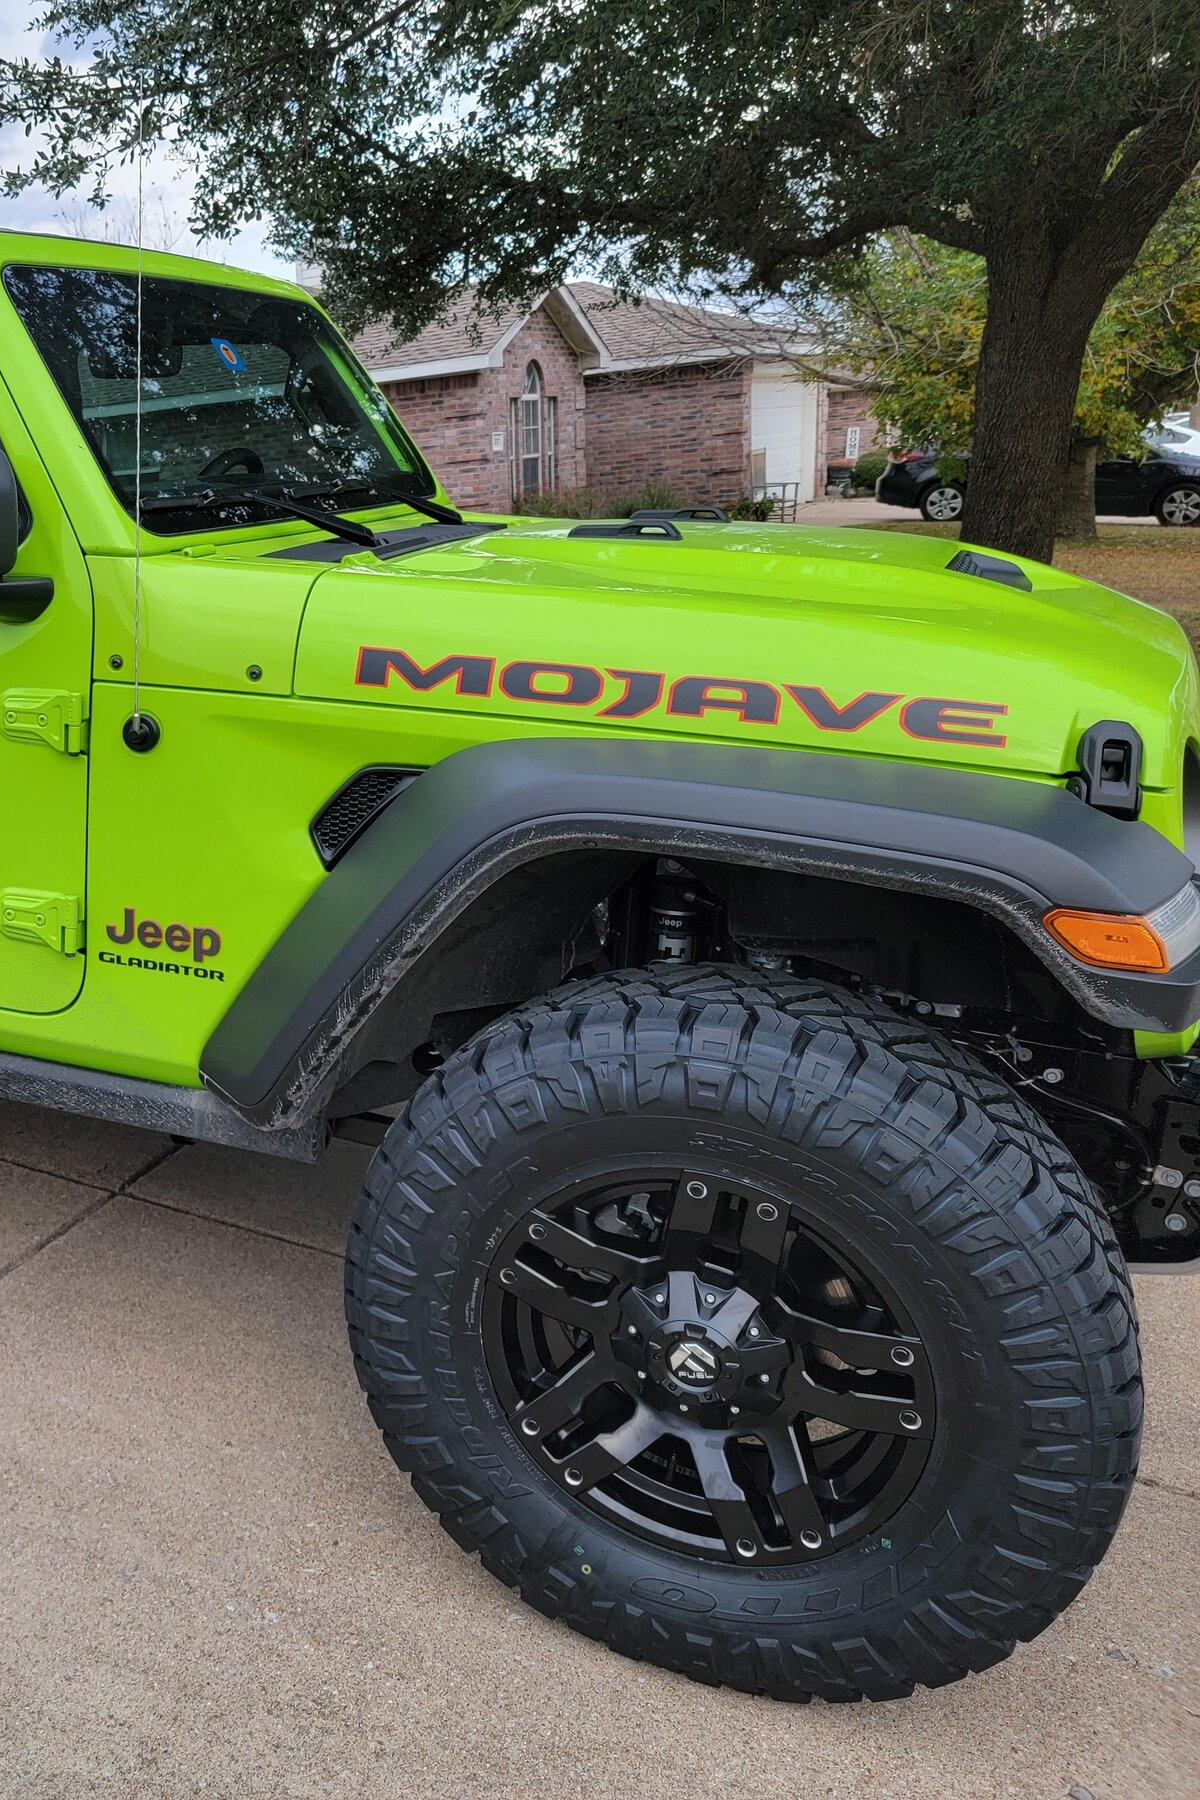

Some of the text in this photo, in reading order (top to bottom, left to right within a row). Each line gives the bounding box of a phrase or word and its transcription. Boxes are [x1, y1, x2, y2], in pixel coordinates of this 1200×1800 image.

[849, 429, 857, 457] HOME
[354, 645, 1009, 749] MOJAVE
[105, 907, 221, 962] Jeep
[658, 917, 683, 928] Jeep
[98, 951, 225, 982] GLADIATOR
[678, 1371, 714, 1379] FUEL
[629, 1509, 963, 1625] NITTO
